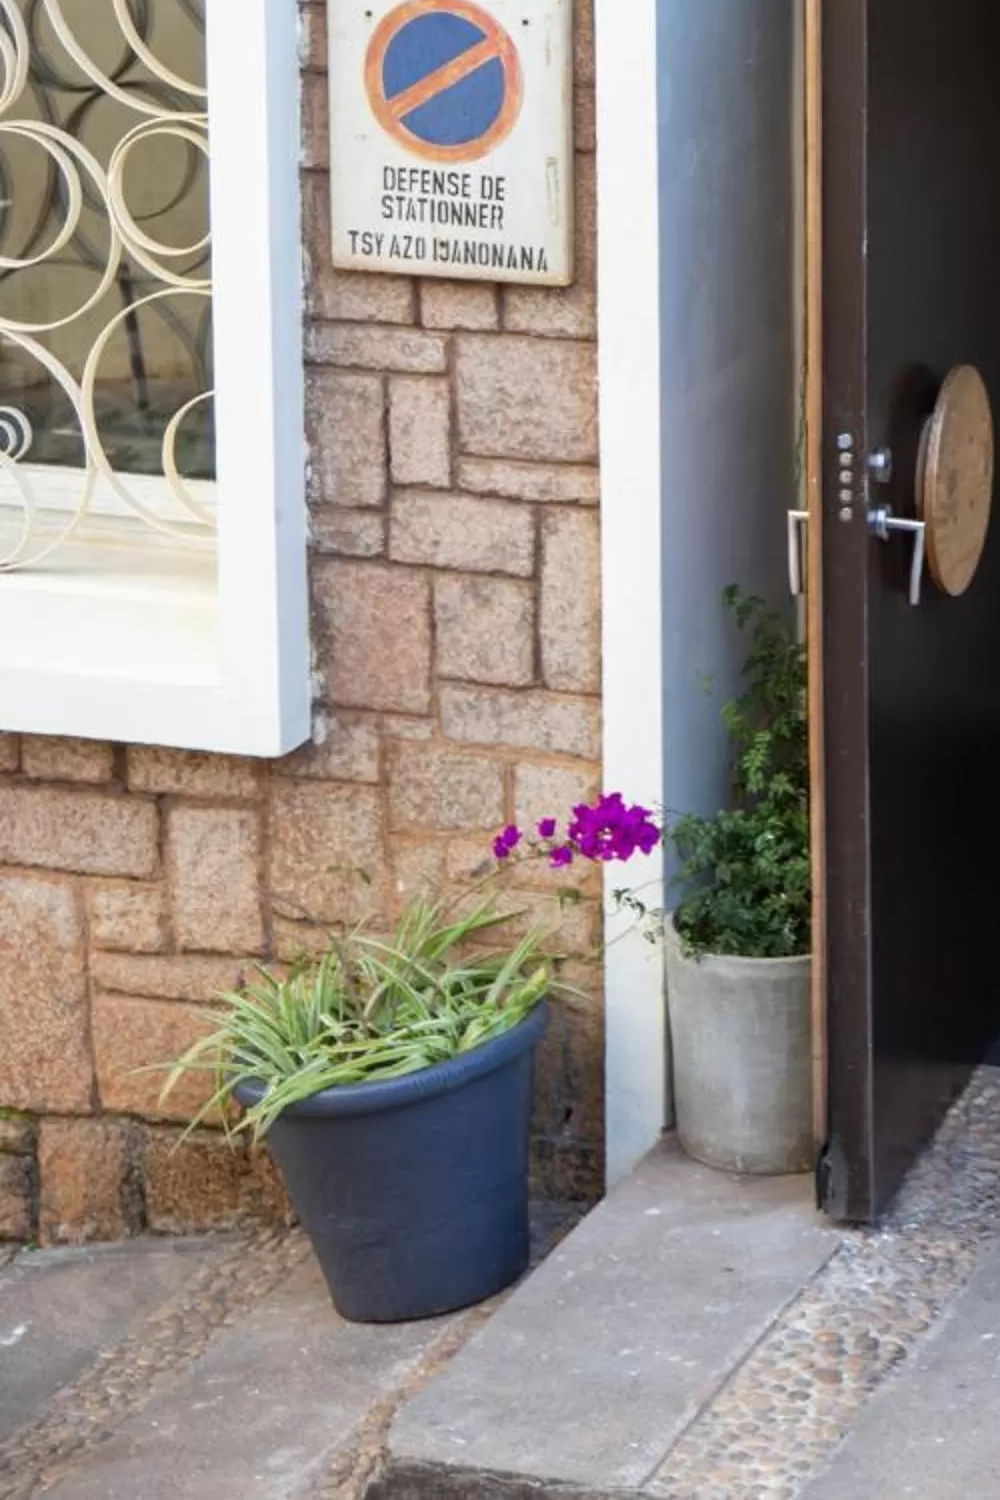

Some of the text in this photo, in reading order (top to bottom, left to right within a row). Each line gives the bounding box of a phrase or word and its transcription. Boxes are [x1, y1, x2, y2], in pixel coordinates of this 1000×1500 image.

[383, 165, 506, 201] DEFENSE DE
[381, 194, 505, 230] STATIONNER
[348, 229, 385, 257] TSY
[389, 234, 426, 260] AZO
